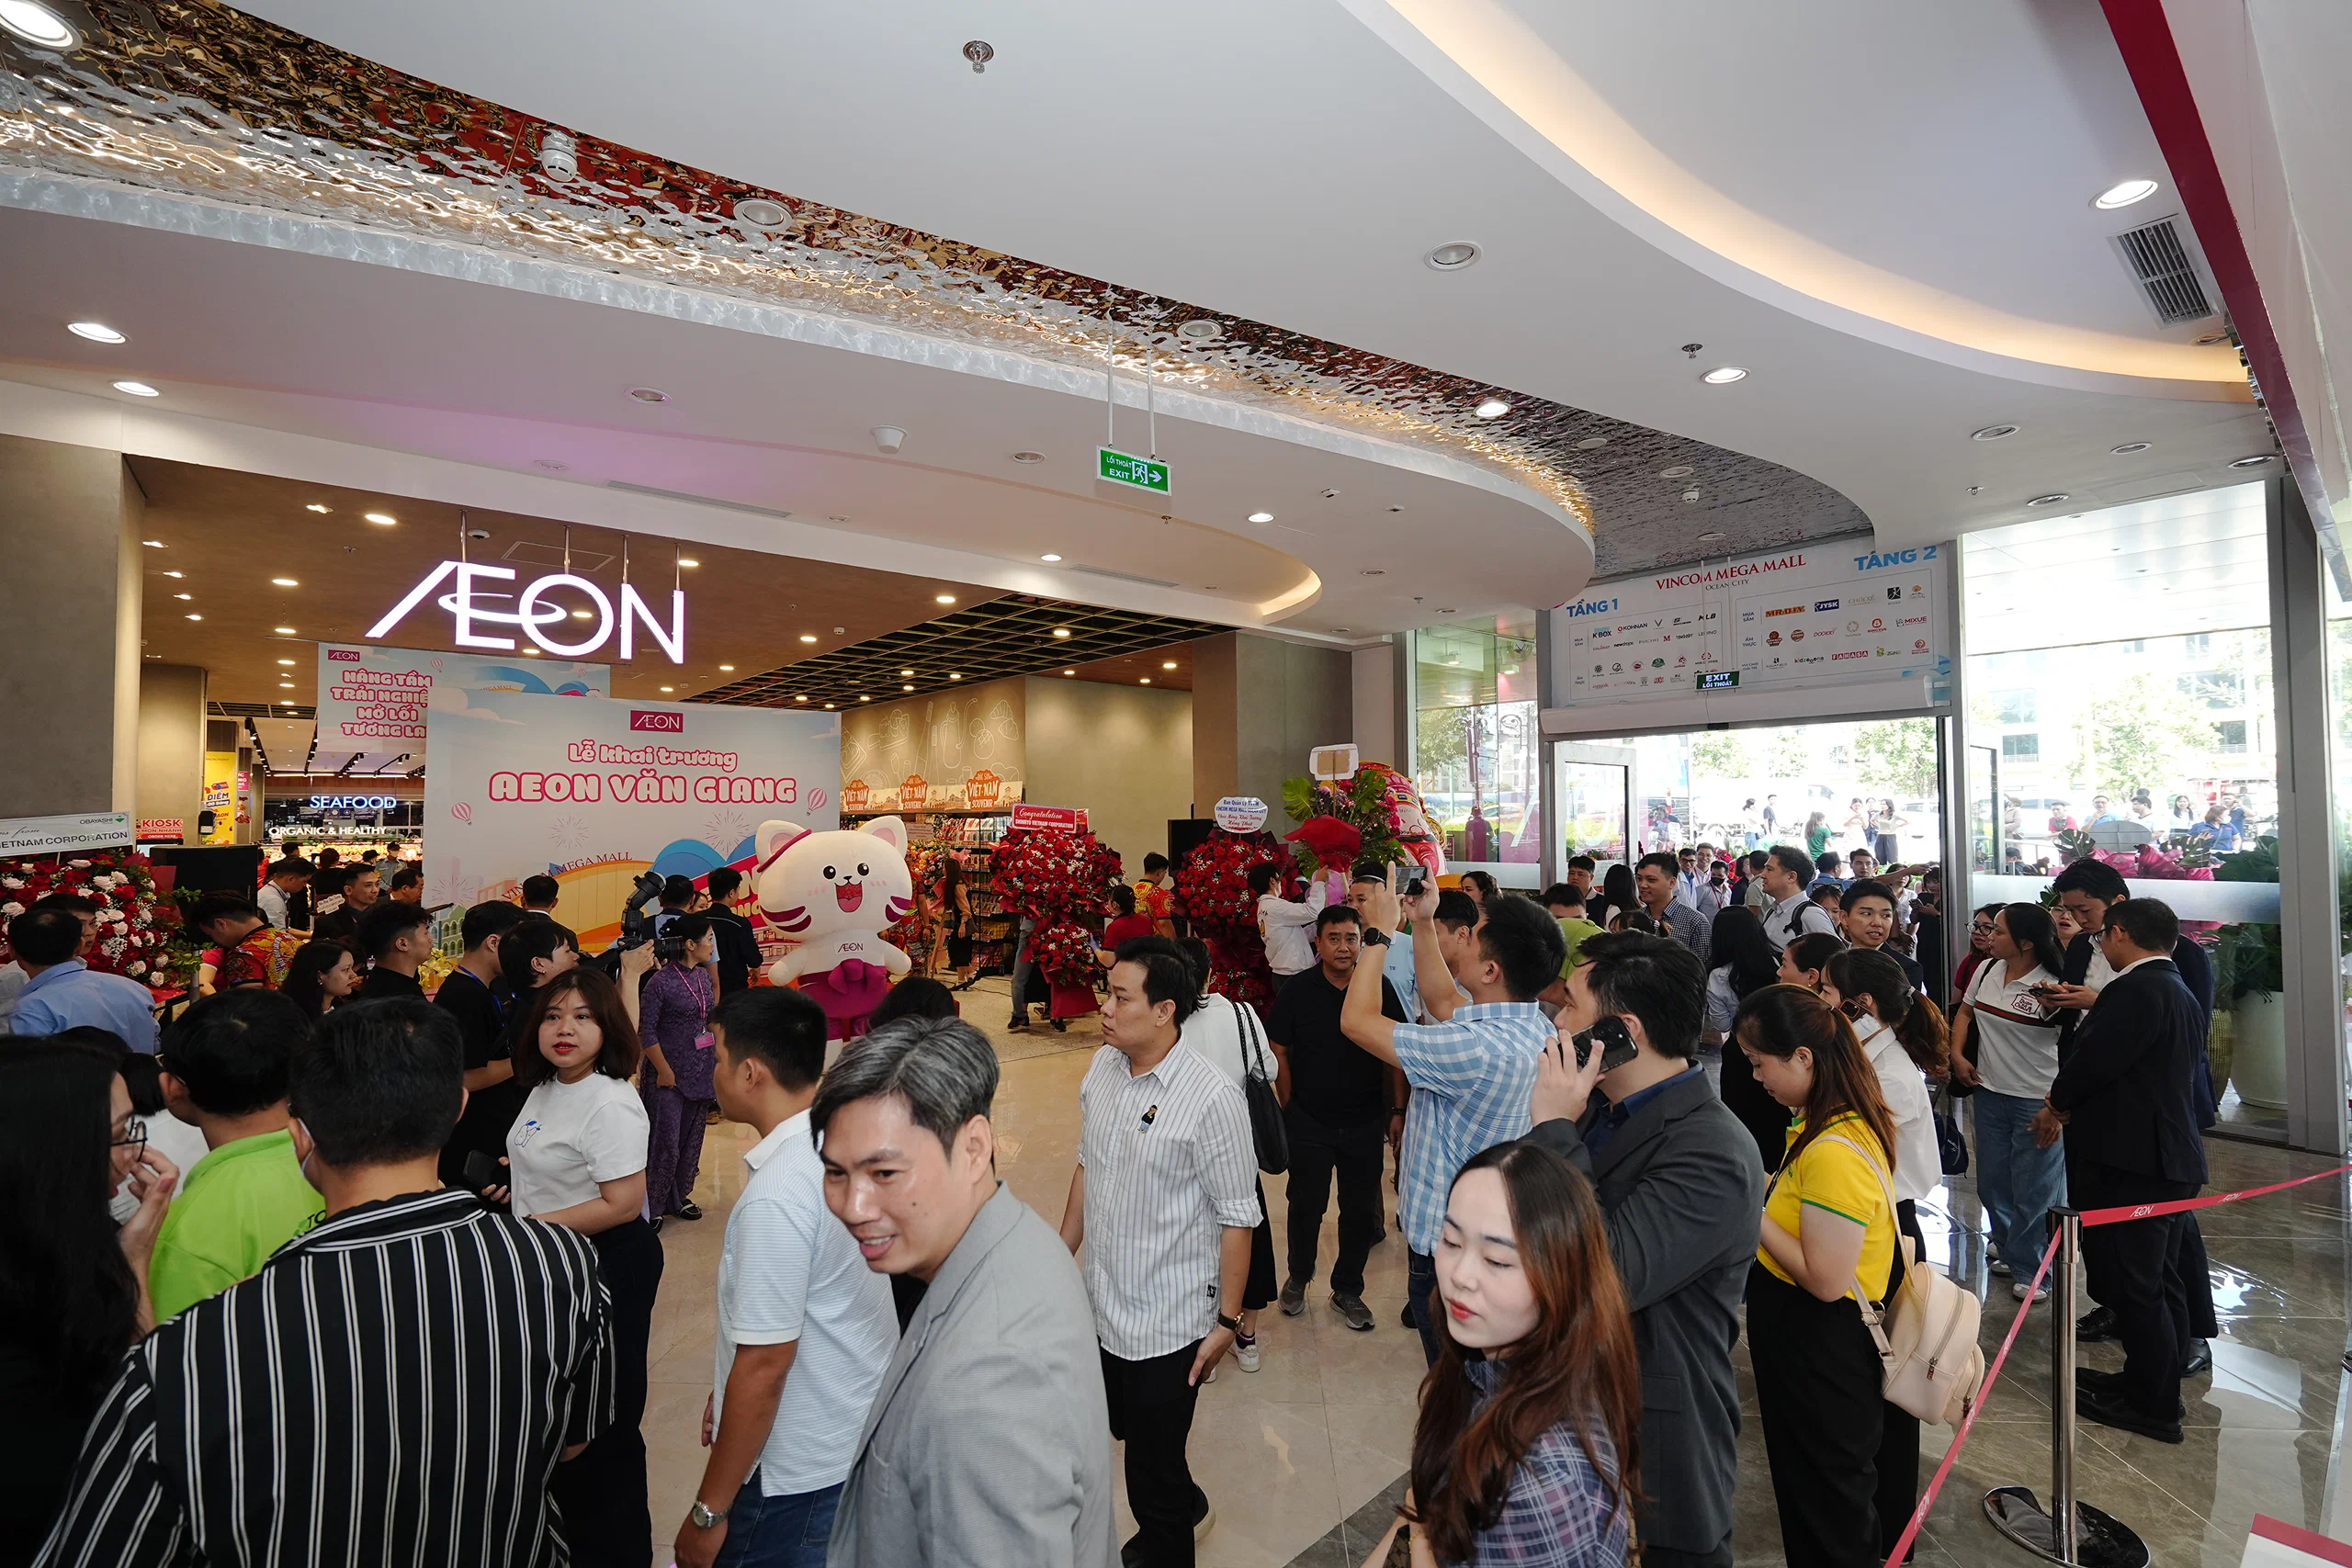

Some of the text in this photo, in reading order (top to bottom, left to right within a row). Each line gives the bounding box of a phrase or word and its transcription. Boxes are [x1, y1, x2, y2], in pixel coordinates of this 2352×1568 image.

[1115, 458, 1132, 468] THOÁT
[1109, 468, 1130, 479] EXIT
[1923, 545, 1937, 560] 2
[1656, 554, 1806, 590] VINCOM MEGA MALL
[1566, 598, 1618, 617] TẦNG 1
[1819, 601, 1838, 609] JYSK
[1623, 623, 1647, 631] KOHNAN
[1832, 650, 1869, 660] FAHASA
[343, 668, 433, 688] NÂNG TẦM
[1706, 673, 1730, 682] EXIT
[331, 685, 428, 708] TRẢI NGHIỆ
[356, 704, 418, 722] MỞ LỐI
[341, 721, 427, 738] TƯƠNG LA
[568, 739, 738, 773] Lễ khai trương
[489, 768, 797, 803] AEON VĂN GIANG
[310, 795, 397, 808] SEAFOOD
[1019, 808, 1063, 819] Congratulation
[142, 819, 181, 828] KIOSK
[45, 831, 128, 845] CORPORATION
[268, 827, 387, 835] ORGANIC & HEALTHY
[502, 852, 632, 900] VINM MEGA MALL
